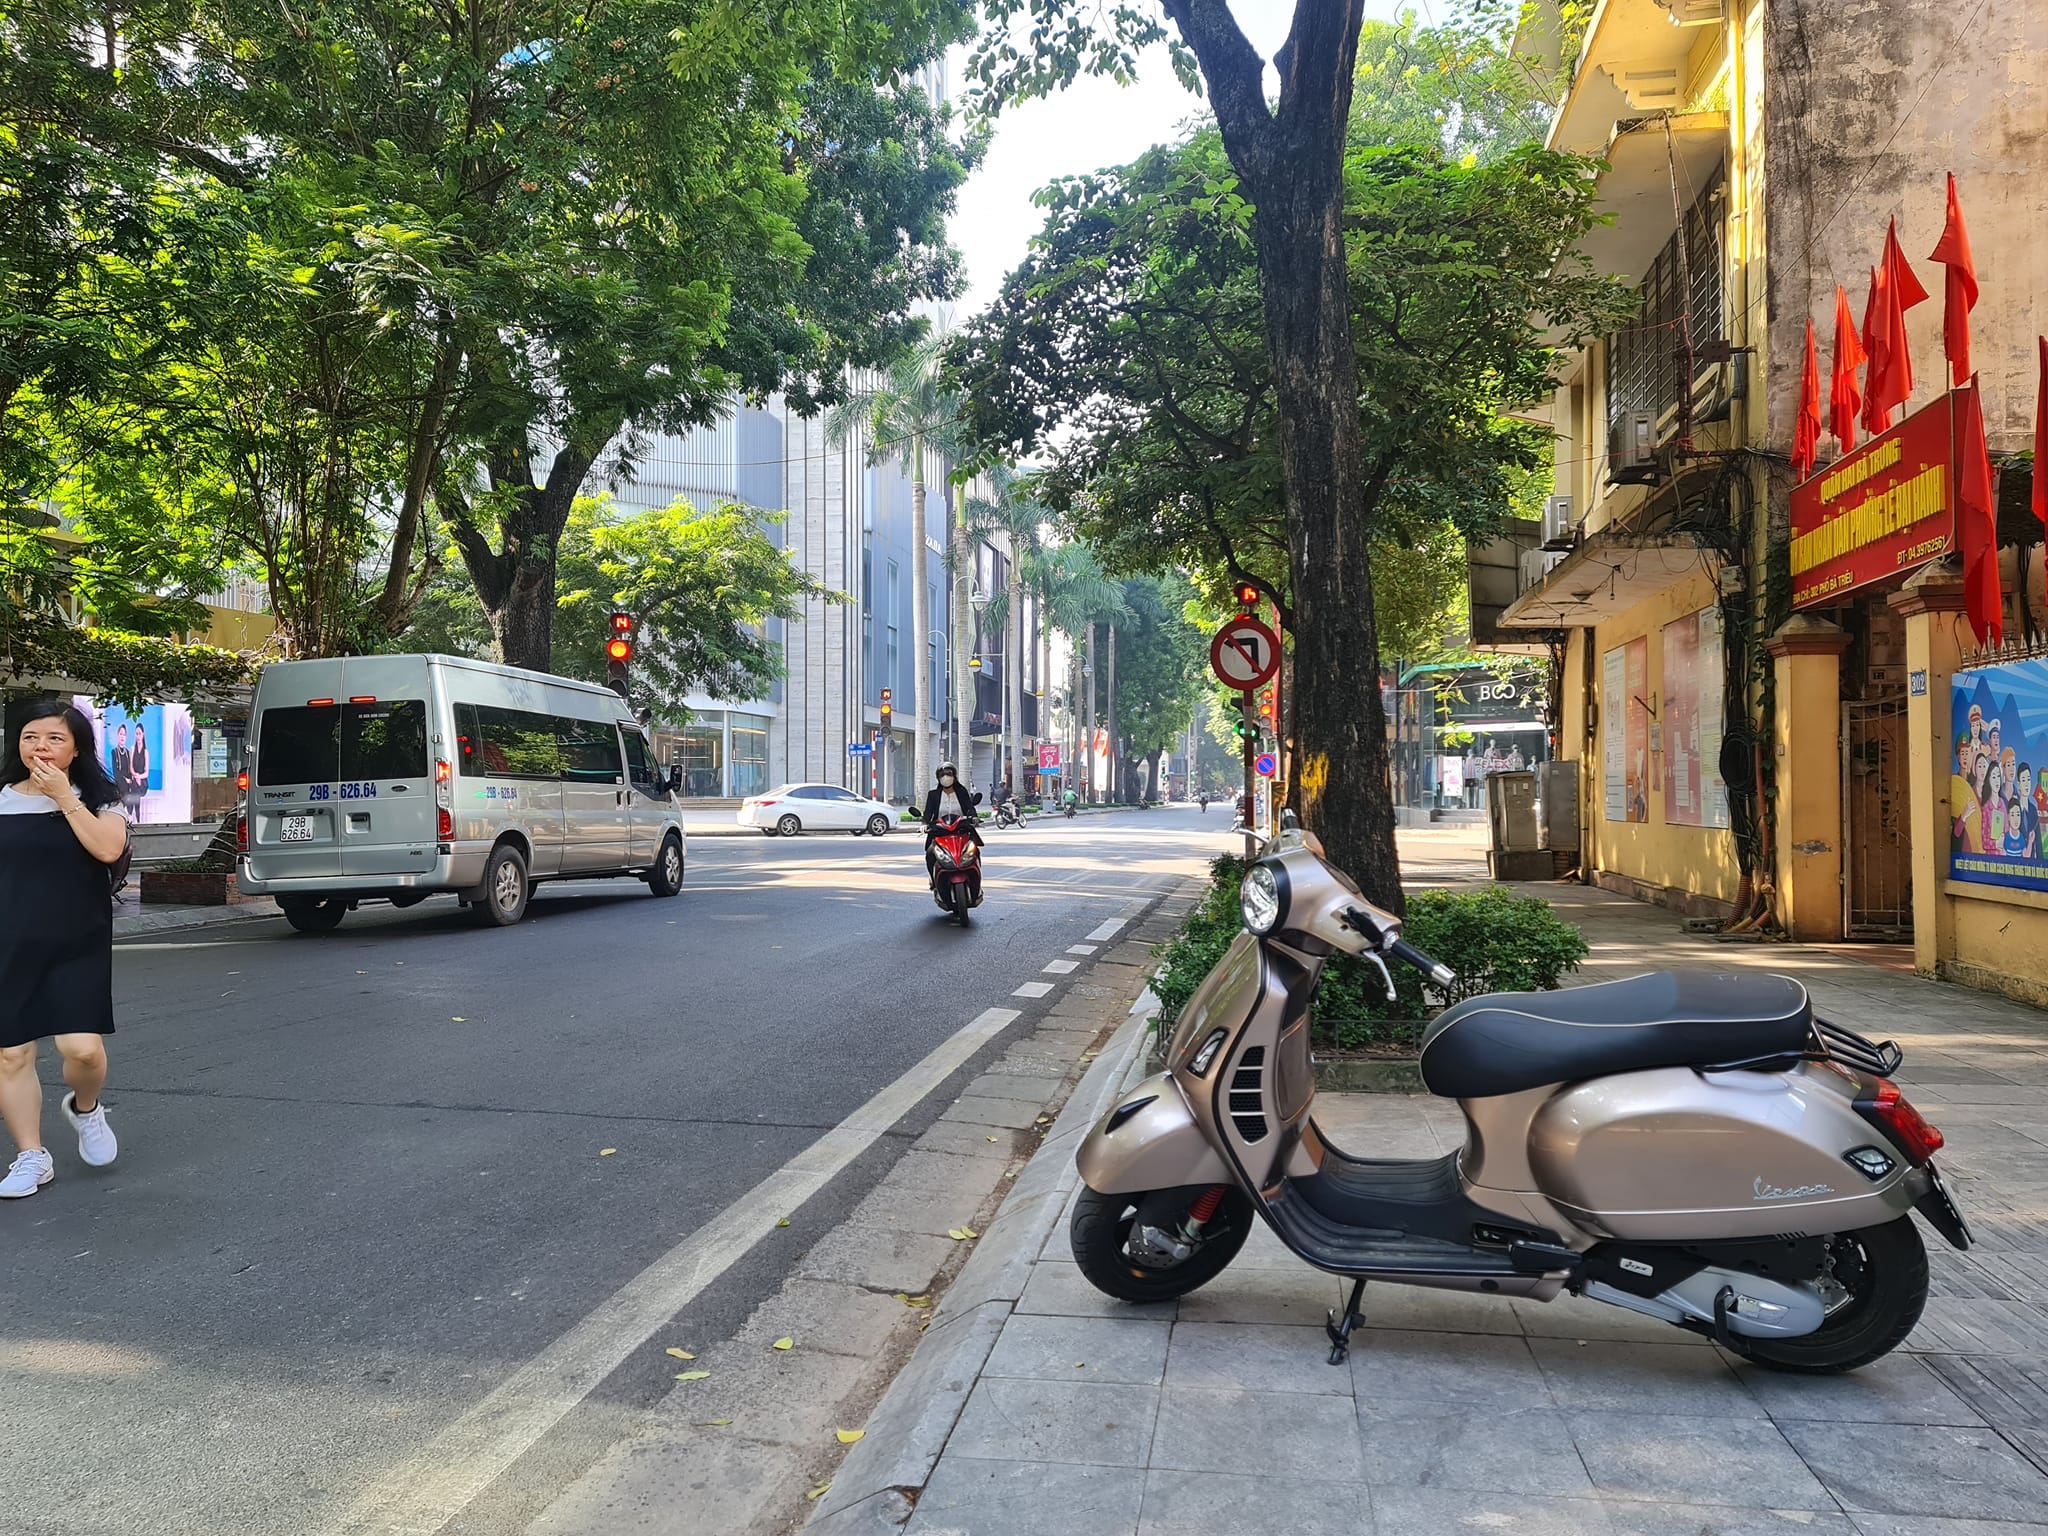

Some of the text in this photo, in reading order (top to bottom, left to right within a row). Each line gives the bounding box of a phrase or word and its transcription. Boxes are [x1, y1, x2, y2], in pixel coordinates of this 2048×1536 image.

[1821, 438, 1901, 505] QUẬN HAI BÀ TRƯNG
[1833, 506, 1849, 558] DÂN
[1850, 488, 1884, 550] PHƯỜNG
[1885, 479, 1896, 536] LÊ
[1896, 475, 1914, 534] ĐẠI
[1914, 463, 1945, 522] HÀNH
[1829, 574, 1838, 590] BÀ
[1838, 569, 1853, 588] TRIỆU
[616, 617, 627, 628] 14
[1911, 671, 1925, 692] 302
[1481, 684, 1516, 700] BOO
[263, 791, 295, 799] TRANSIT
[309, 784, 329, 801] 29B
[340, 782, 377, 799] 626.64
[486, 786, 496, 799] 29B
[500, 787, 517, 799] 626.64
[288, 817, 306, 828] 29B
[281, 828, 311, 840] 626.64
[1753, 1175, 1835, 1200] Vespa
